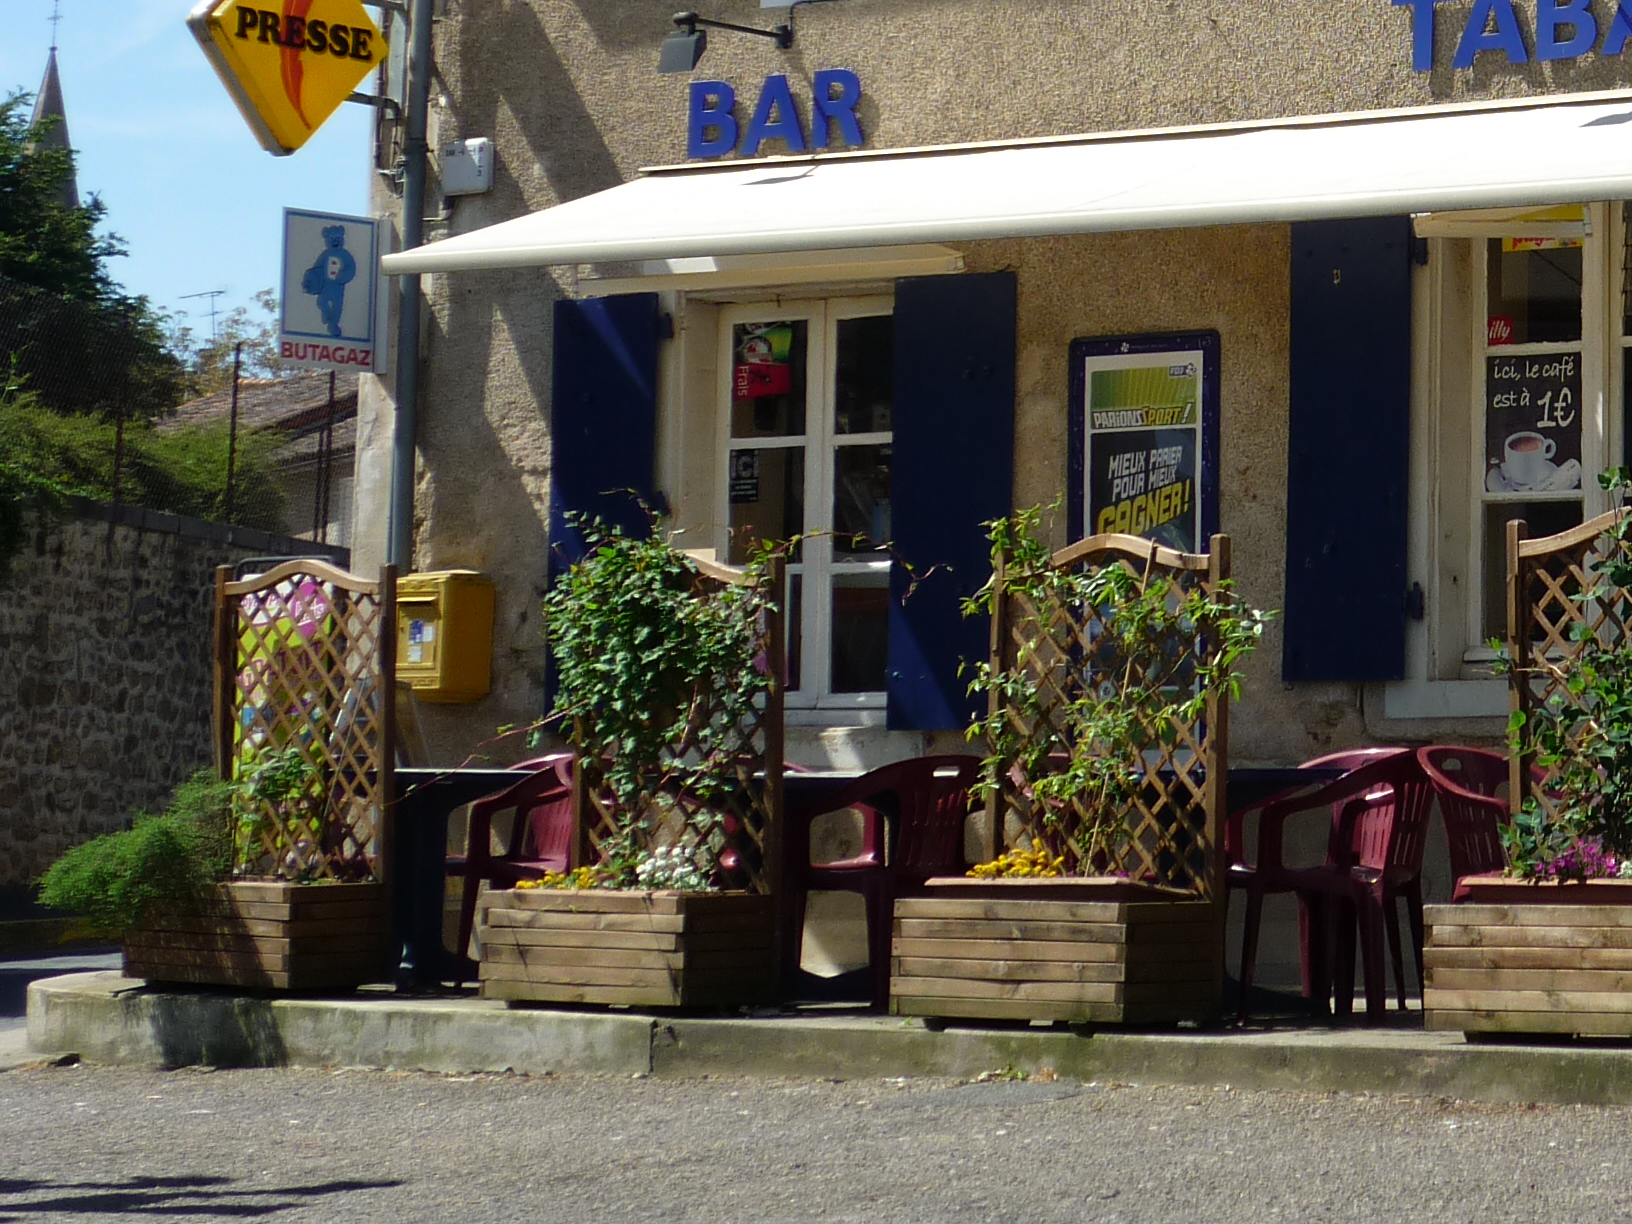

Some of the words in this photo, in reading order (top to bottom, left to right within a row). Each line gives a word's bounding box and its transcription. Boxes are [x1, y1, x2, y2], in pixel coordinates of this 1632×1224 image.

[234, 5, 373, 62] PRESSE
[687, 69, 864, 158] BAR
[1489, 320, 1510, 342] illy
[280, 340, 372, 367] BUTAGAZ
[1525, 360, 1540, 379] le
[1542, 356, 1575, 382] café
[737, 365, 750, 396] Frais
[1493, 390, 1517, 408] est
[1520, 387, 1531, 406] à
[1536, 386, 1575, 428] 1€
[1107, 450, 1147, 480] MIEUX
[1148, 445, 1183, 469] PARIER
[1111, 472, 1145, 503] POUR
[1147, 465, 1177, 491] MIEUX
